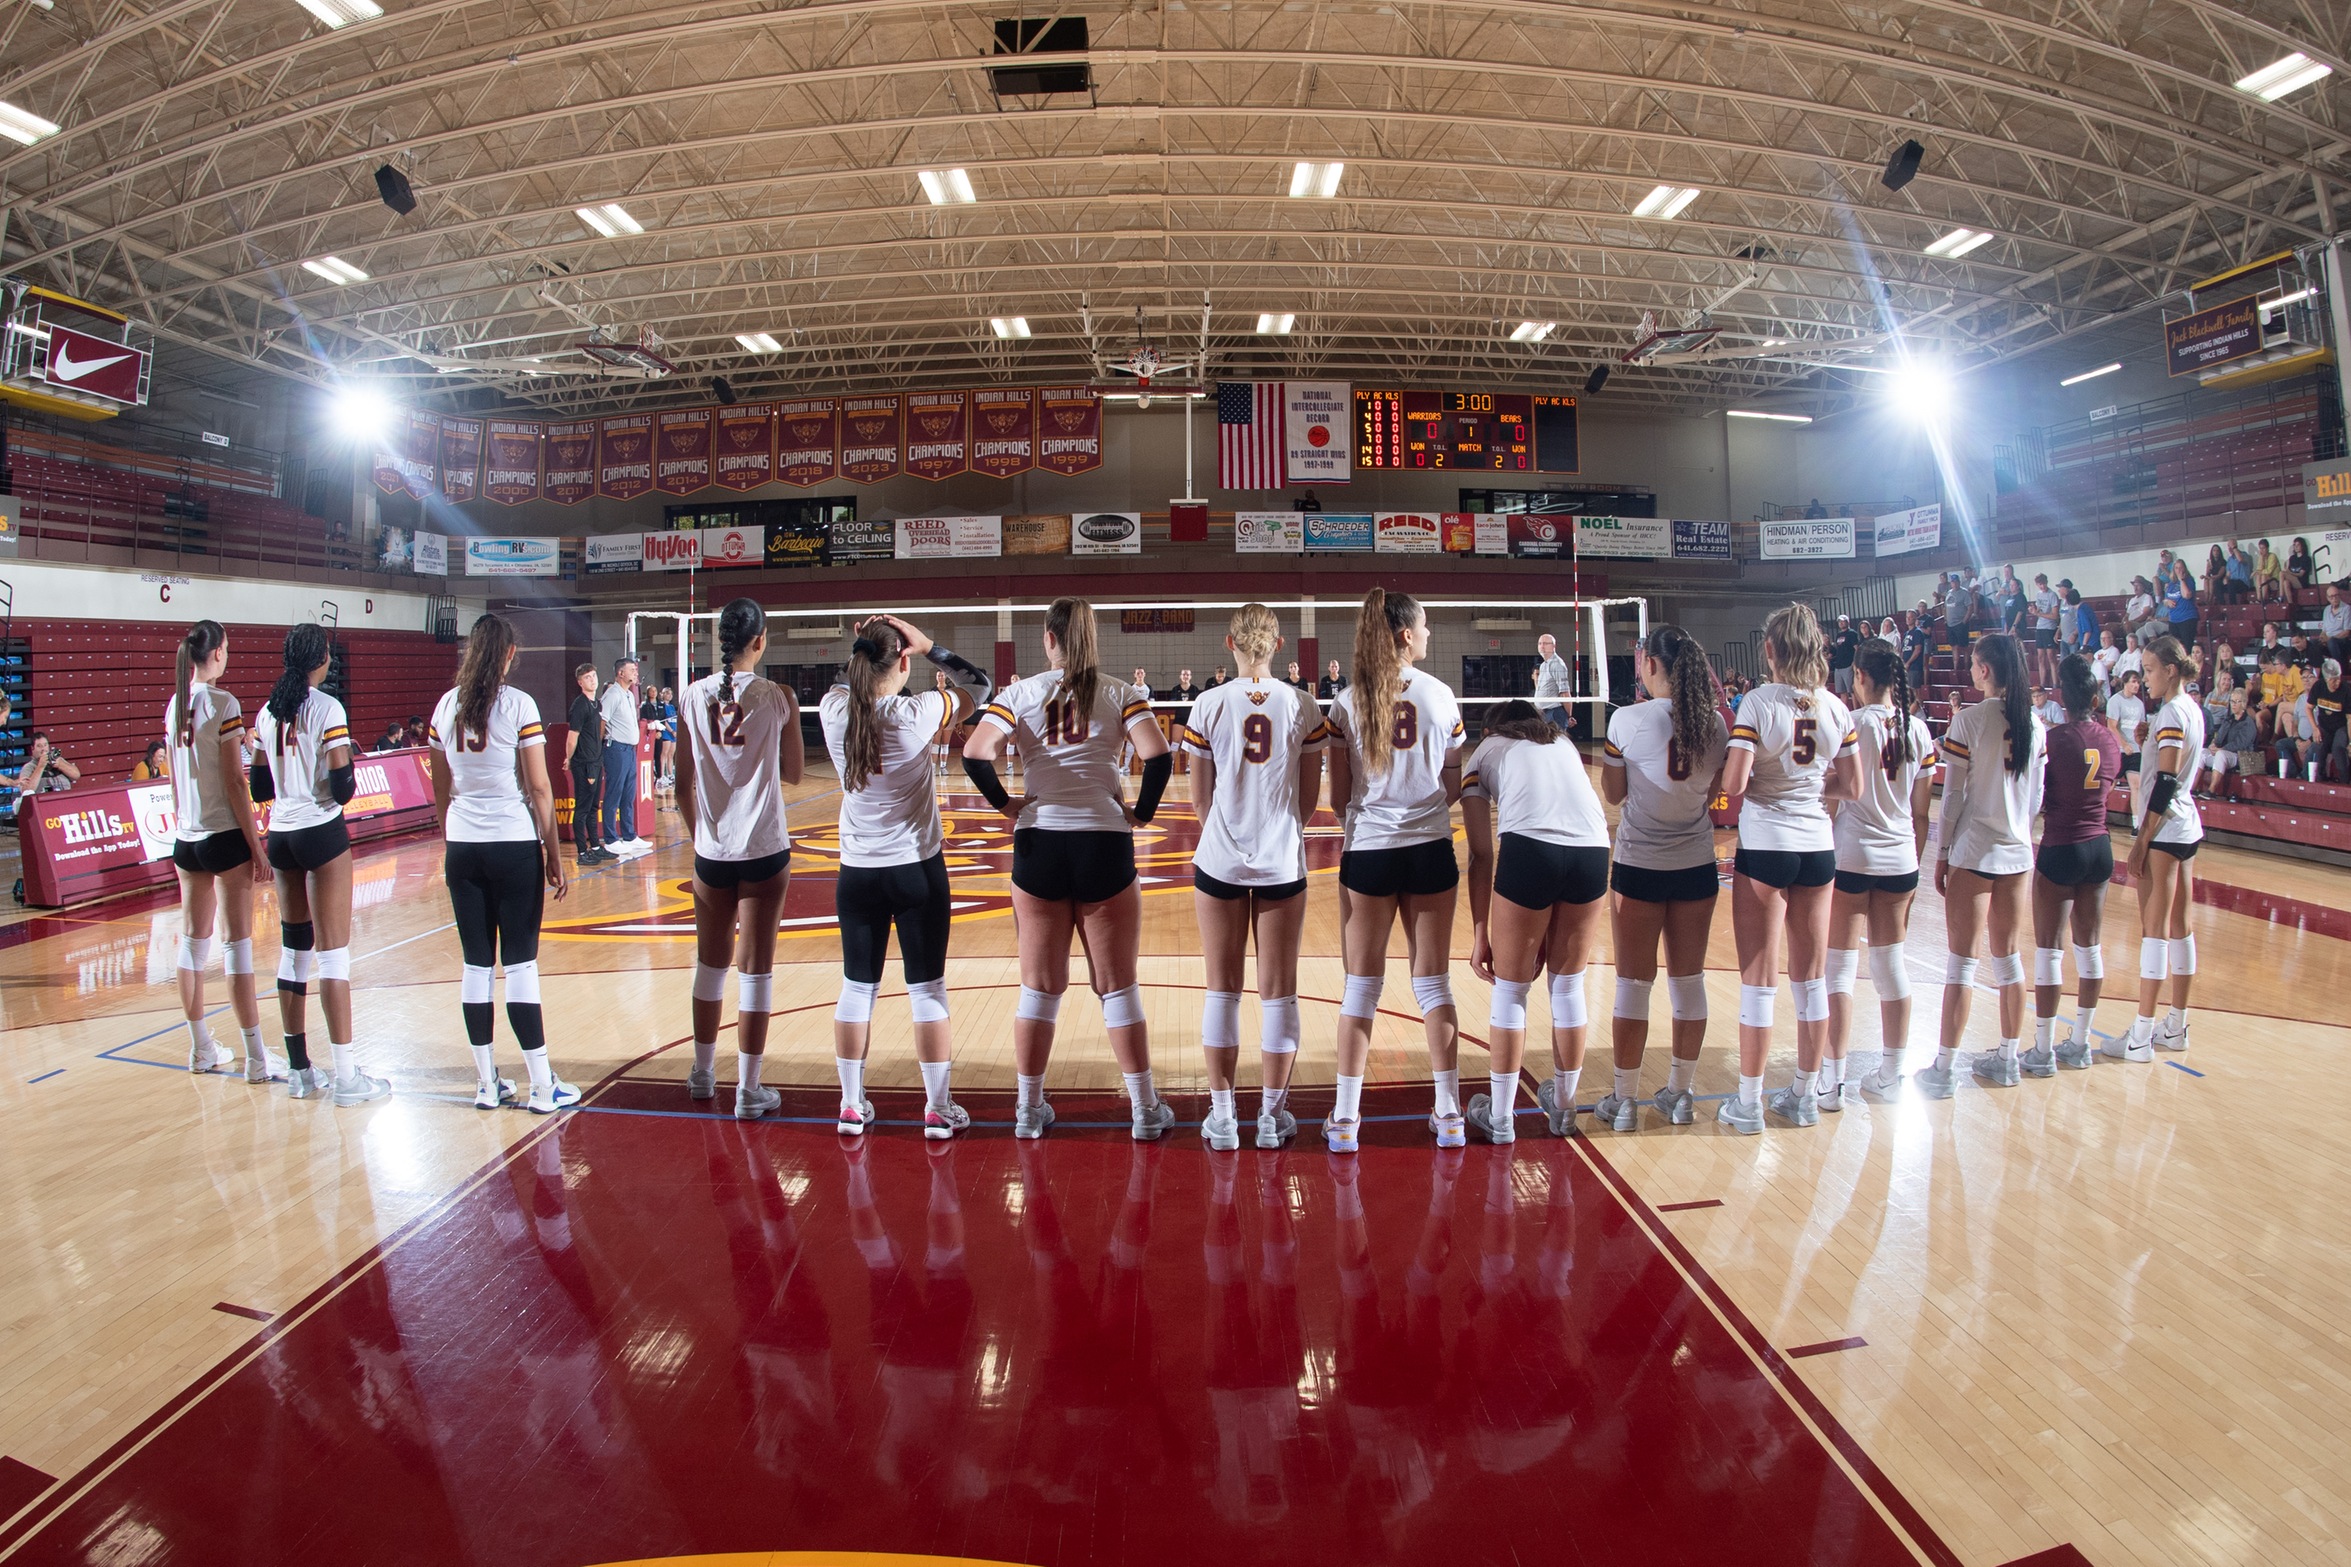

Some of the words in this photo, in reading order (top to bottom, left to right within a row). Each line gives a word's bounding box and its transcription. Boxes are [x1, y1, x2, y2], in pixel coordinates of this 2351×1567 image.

[2171, 331, 2188, 349] Jack
[2188, 314, 2225, 338] Blackwell
[2225, 306, 2255, 328] Family
[2178, 339, 2213, 357] SUPPORTING
[2213, 334, 2233, 347] INDIAN
[2233, 328, 2249, 340] HILLS
[2199, 351, 2216, 361] SINCE
[2216, 346, 2229, 356] 1965
[909, 395, 938, 407] INDIAN
[940, 394, 964, 404] HILLS
[975, 392, 1004, 403] INDIAN
[1007, 391, 1031, 402] HILLS
[1042, 390, 1071, 401] INDIAN
[1303, 391, 1332, 400] NATIONAL
[1356, 392, 1370, 400] PLY
[1374, 392, 1382, 400] AC
[1385, 392, 1399, 400] KLS
[1535, 397, 1548, 405] PLY
[1562, 398, 1575, 406] KLS
[781, 403, 809, 414] INDIAN
[810, 401, 834, 412] HILLS
[844, 400, 873, 411] INDIAN
[874, 398, 898, 409] HILLS
[1292, 402, 1344, 412] INTERCOLLEGIATE
[1375, 401, 1381, 411] 0
[1456, 394, 1491, 411] 3:00
[660, 413, 686, 425] INDIAN
[688, 411, 710, 422] HILLS
[720, 408, 747, 420] INDIAN
[748, 405, 771, 417] HILLS
[1306, 414, 1330, 423] RECORD
[1364, 412, 1372, 421] 4
[1375, 412, 1381, 421] 0
[1407, 412, 1442, 421] WARRIORS
[1500, 415, 1522, 423] BEARS
[2091, 409, 2110, 419] BALCONY
[2111, 406, 2116, 414] E
[458, 422, 479, 434] HILLS
[491, 422, 517, 434] INDIAN
[518, 424, 539, 435] HILLS
[603, 419, 629, 431] INDIAN
[630, 416, 651, 427] HILLS
[1375, 423, 1382, 433] 0
[548, 425, 574, 436] INDIAN
[1427, 422, 1437, 439] 0
[1515, 425, 1525, 441] 0
[204, 433, 223, 443] BALCONY
[1375, 434, 1382, 444] 0
[908, 443, 964, 461] CHAMPIONS
[975, 441, 1031, 459] CHAMPIONS
[1041, 439, 1098, 456] CHAMPIONS
[1362, 445, 1372, 454] 14
[1375, 445, 1382, 455] 0
[1410, 442, 1425, 451] WON
[1458, 444, 1482, 452] MATCH
[1512, 445, 1526, 453] WON
[780, 450, 833, 469] CHAMPIONS
[843, 447, 897, 466] CHAMPIONS
[1052, 455, 1088, 465] 1999
[1300, 450, 1328, 459] STRAIGHT
[1330, 450, 1346, 459] WINS
[1362, 457, 1372, 466] 15
[1376, 456, 1382, 466] 0
[1416, 453, 1425, 466] 0
[1435, 454, 1444, 467] 2
[718, 455, 770, 473] CHAMPIONS
[918, 460, 953, 470] 1997
[984, 457, 1021, 467] 1998
[1495, 455, 1503, 468] 2
[1517, 455, 1526, 469] 0
[602, 463, 650, 483] CHAMPIONS
[658, 459, 708, 478] CHAMPIONS
[488, 470, 537, 487] CHAMPIONS
[546, 470, 593, 488] CHAMPIONS
[2306, 479, 2317, 487] GO
[2307, 501, 2333, 510] Download
[904, 519, 945, 530] REED
[1311, 521, 1370, 531] SCHROEDER
[1379, 515, 1436, 532] REED
[1445, 516, 1459, 524] olé
[1581, 518, 1623, 530] NOEL
[1626, 523, 1663, 532] Insurance
[8, 523, 17, 532] TV
[832, 522, 872, 533] FLOOR
[908, 529, 950, 537] OVERHEAD
[1005, 523, 1045, 533] WAREHOUSE
[1693, 522, 1728, 536] TEAM
[1767, 524, 1848, 537] HINDMAN/PERSON
[768, 534, 825, 554] Barbecue
[832, 535, 845, 544] to
[847, 533, 892, 543] CEILING
[910, 536, 951, 548] DOORS
[1250, 531, 1276, 545] Shop
[1676, 535, 1697, 543] Real
[1700, 536, 1728, 544] Estate
[473, 541, 508, 554] Bowling
[722, 541, 746, 553] OTTUMWA
[1677, 545, 1728, 553] 641.682.2221
[141, 574, 168, 583] RESERVED
[169, 576, 190, 586] SEATING
[160, 584, 171, 603] C
[365, 599, 373, 614] D
[1123, 610, 1153, 624] JAZZ
[1162, 610, 1192, 624] BAND
[709, 702, 745, 746] 12
[1045, 698, 1090, 746] 10
[1392, 700, 1417, 750] 8
[1244, 713, 1272, 764] 9
[1792, 718, 1817, 766] 5
[2084, 749, 2101, 789] 2
[45, 817, 61, 830] GO
[59, 809, 124, 844] Hills
[122, 822, 135, 834] TV
[54, 847, 90, 861] Download
[90, 845, 102, 854] the
[103, 843, 117, 853] App
[117, 838, 141, 849] Today!
